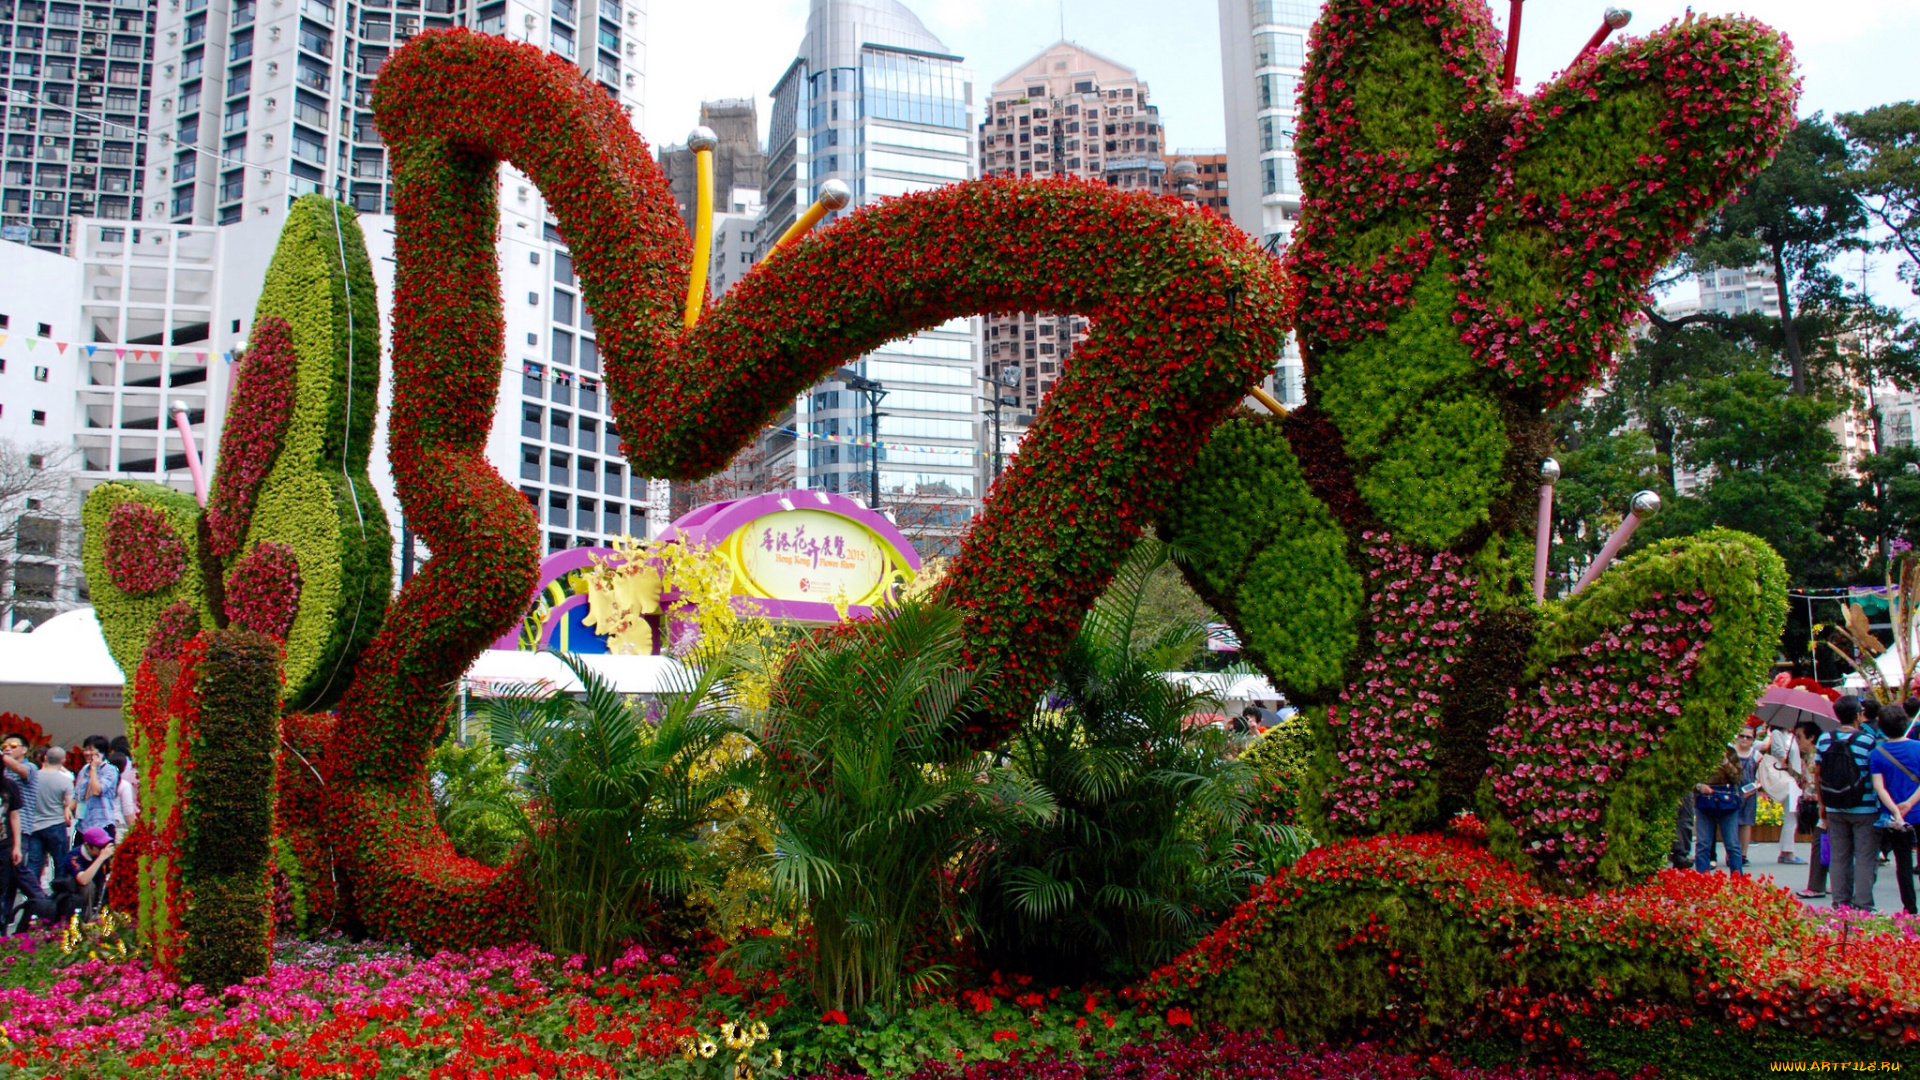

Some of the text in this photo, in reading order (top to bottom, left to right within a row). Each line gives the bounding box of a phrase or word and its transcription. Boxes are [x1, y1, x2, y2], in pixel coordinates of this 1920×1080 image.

[775, 554, 855, 569] Hong Kong Flower Show
[847, 549, 865, 561] 2015
